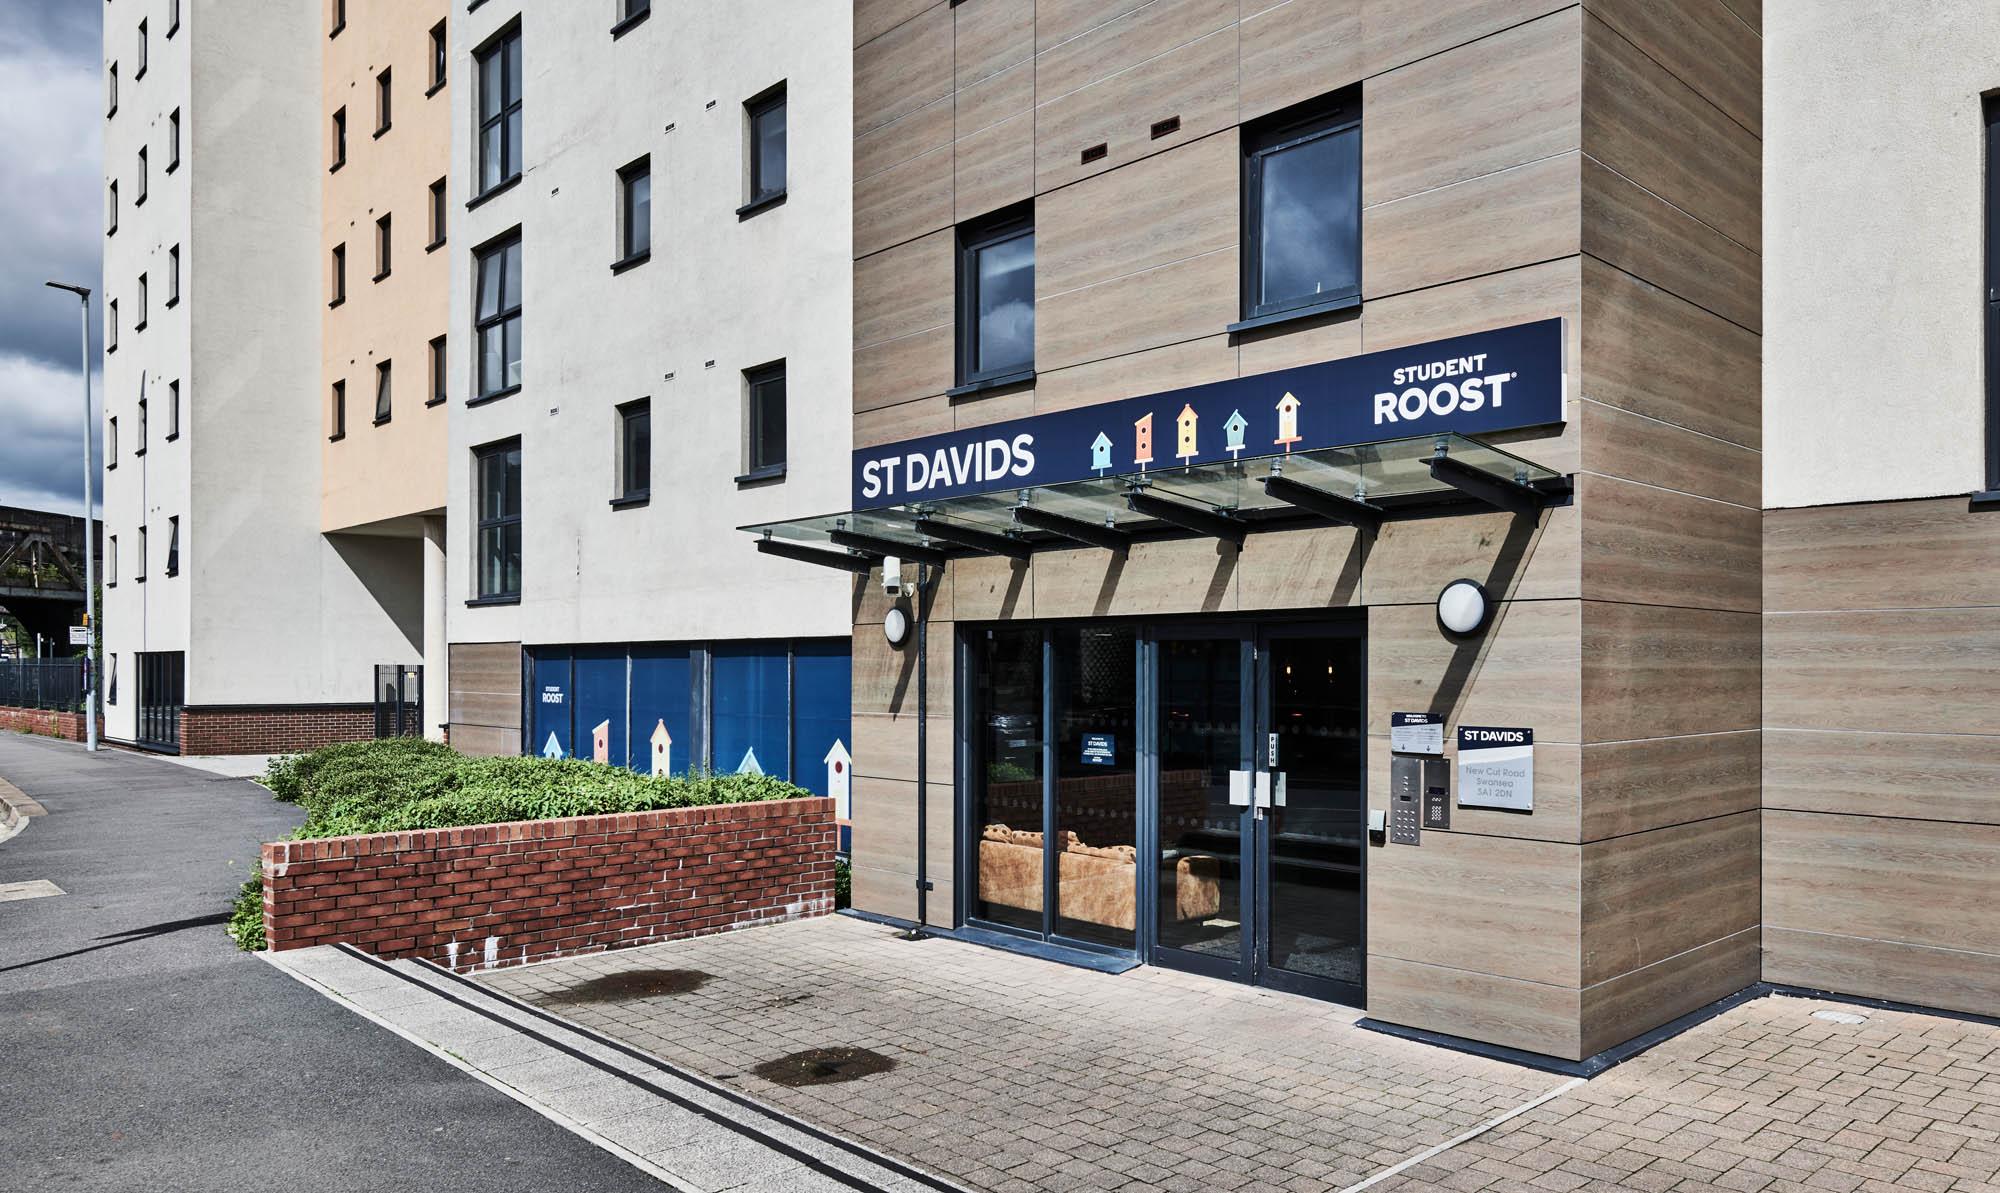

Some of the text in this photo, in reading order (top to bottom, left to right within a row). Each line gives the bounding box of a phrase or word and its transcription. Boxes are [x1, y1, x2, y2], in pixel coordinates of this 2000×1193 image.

[1393, 353, 1487, 386] STUDENT
[862, 433, 1035, 498] ST DAVIDS
[542, 692, 564, 704] ROOST
[1464, 730, 1524, 742] ST DAVIDS
[1466, 765, 1525, 778] New Cut Road
[1476, 777, 1514, 787] Swansea
[1477, 787, 1513, 798] SA1 2DN
